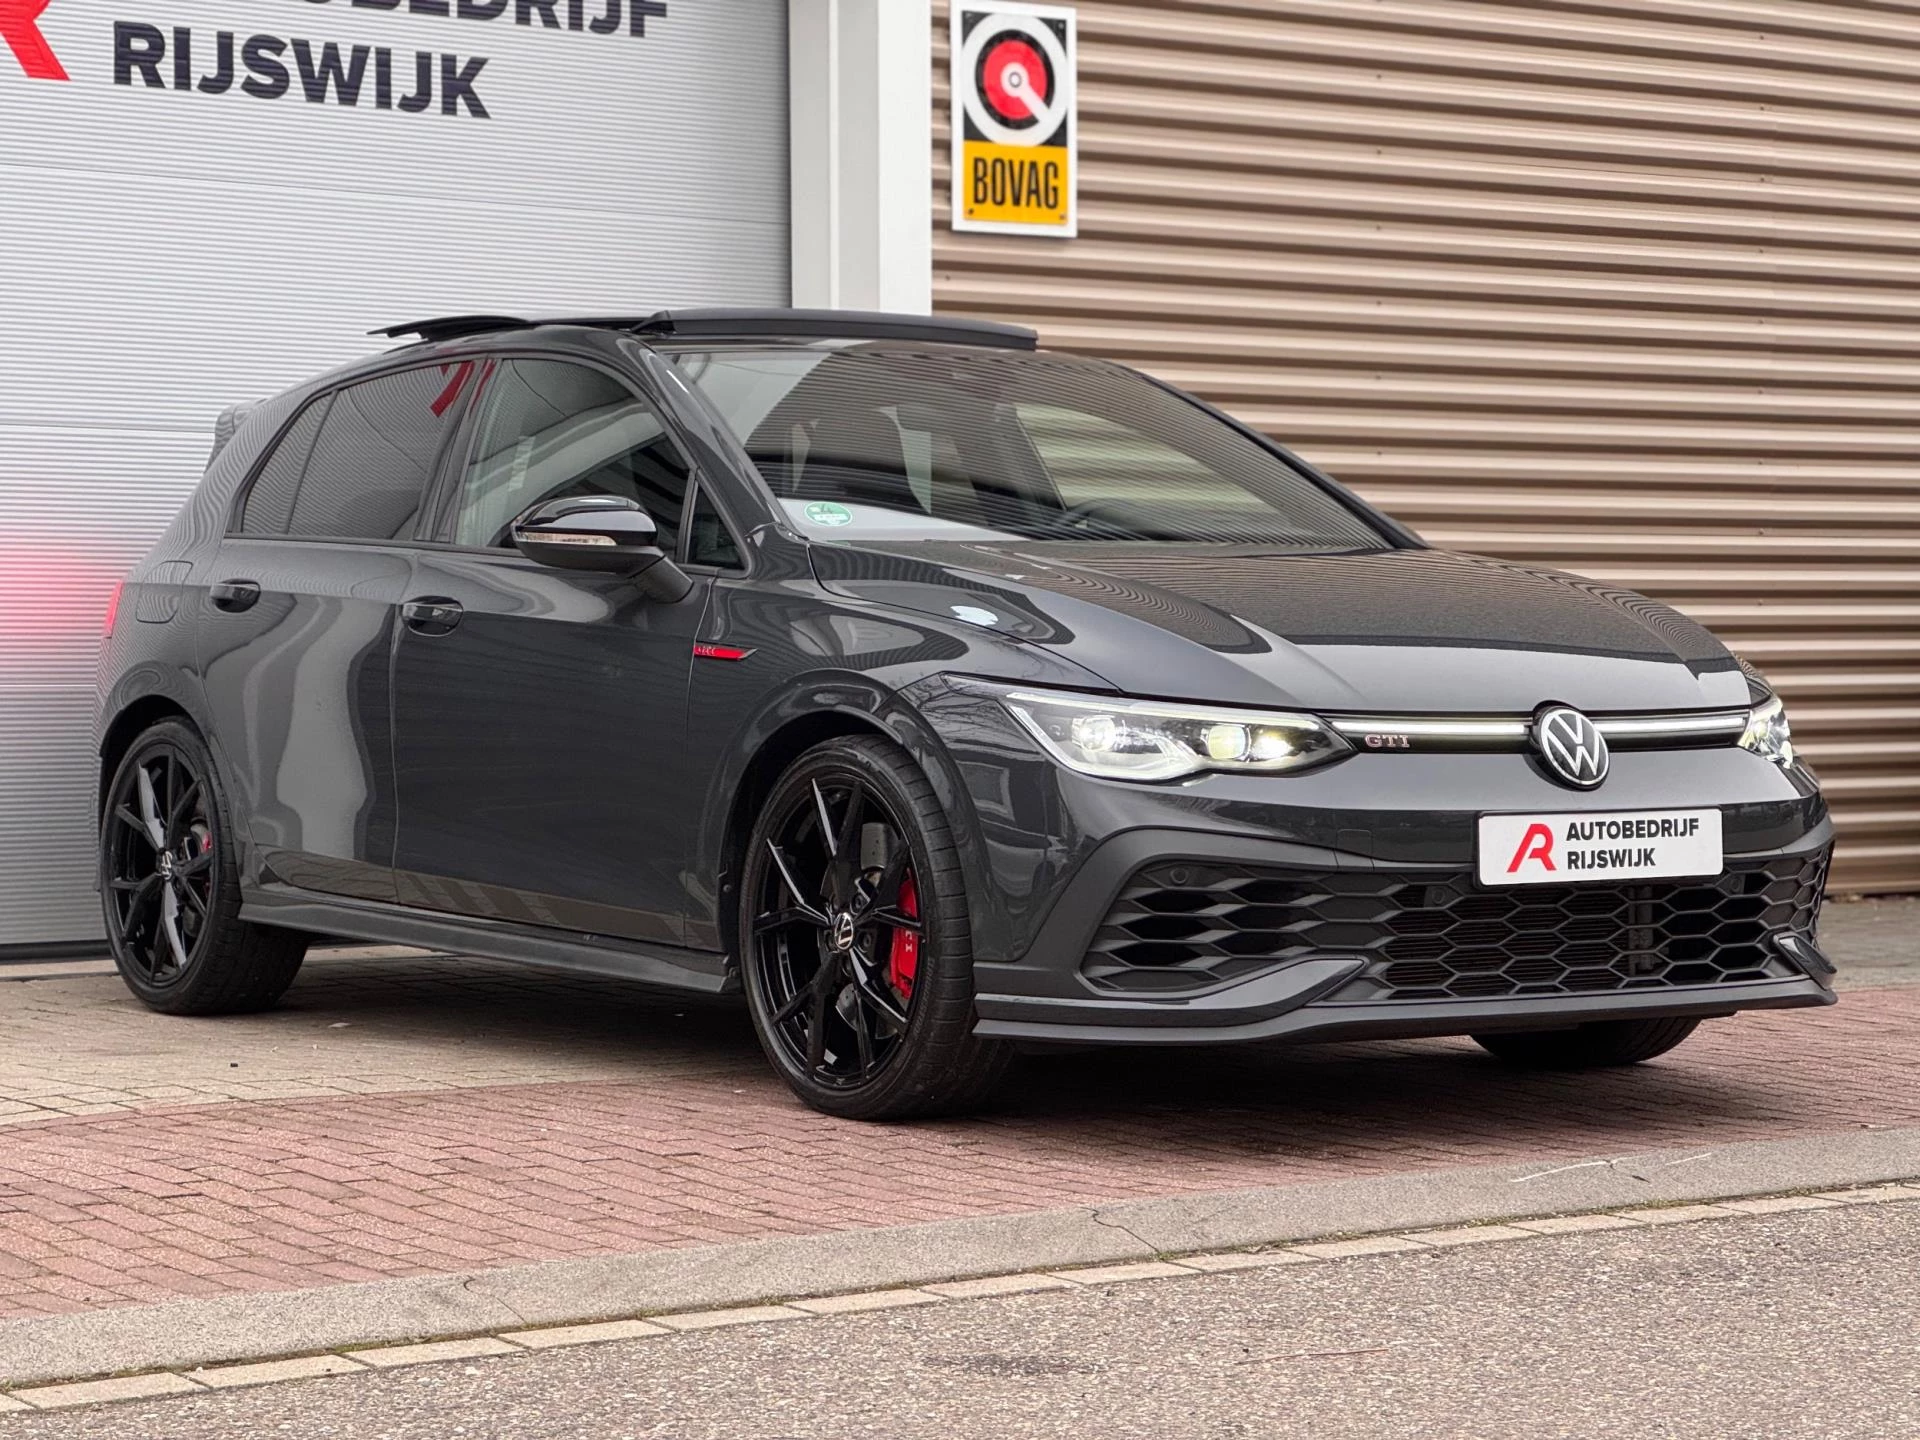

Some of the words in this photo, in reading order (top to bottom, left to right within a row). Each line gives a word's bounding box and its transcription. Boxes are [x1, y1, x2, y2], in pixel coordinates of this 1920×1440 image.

[113, 20, 491, 119] RIJSWIJK
[973, 156, 1059, 210] BOVAG
[1364, 733, 1411, 749] GTI
[1566, 817, 1699, 842] AUTOBEDRIJF
[1566, 847, 1657, 870] RIJSWIJK
